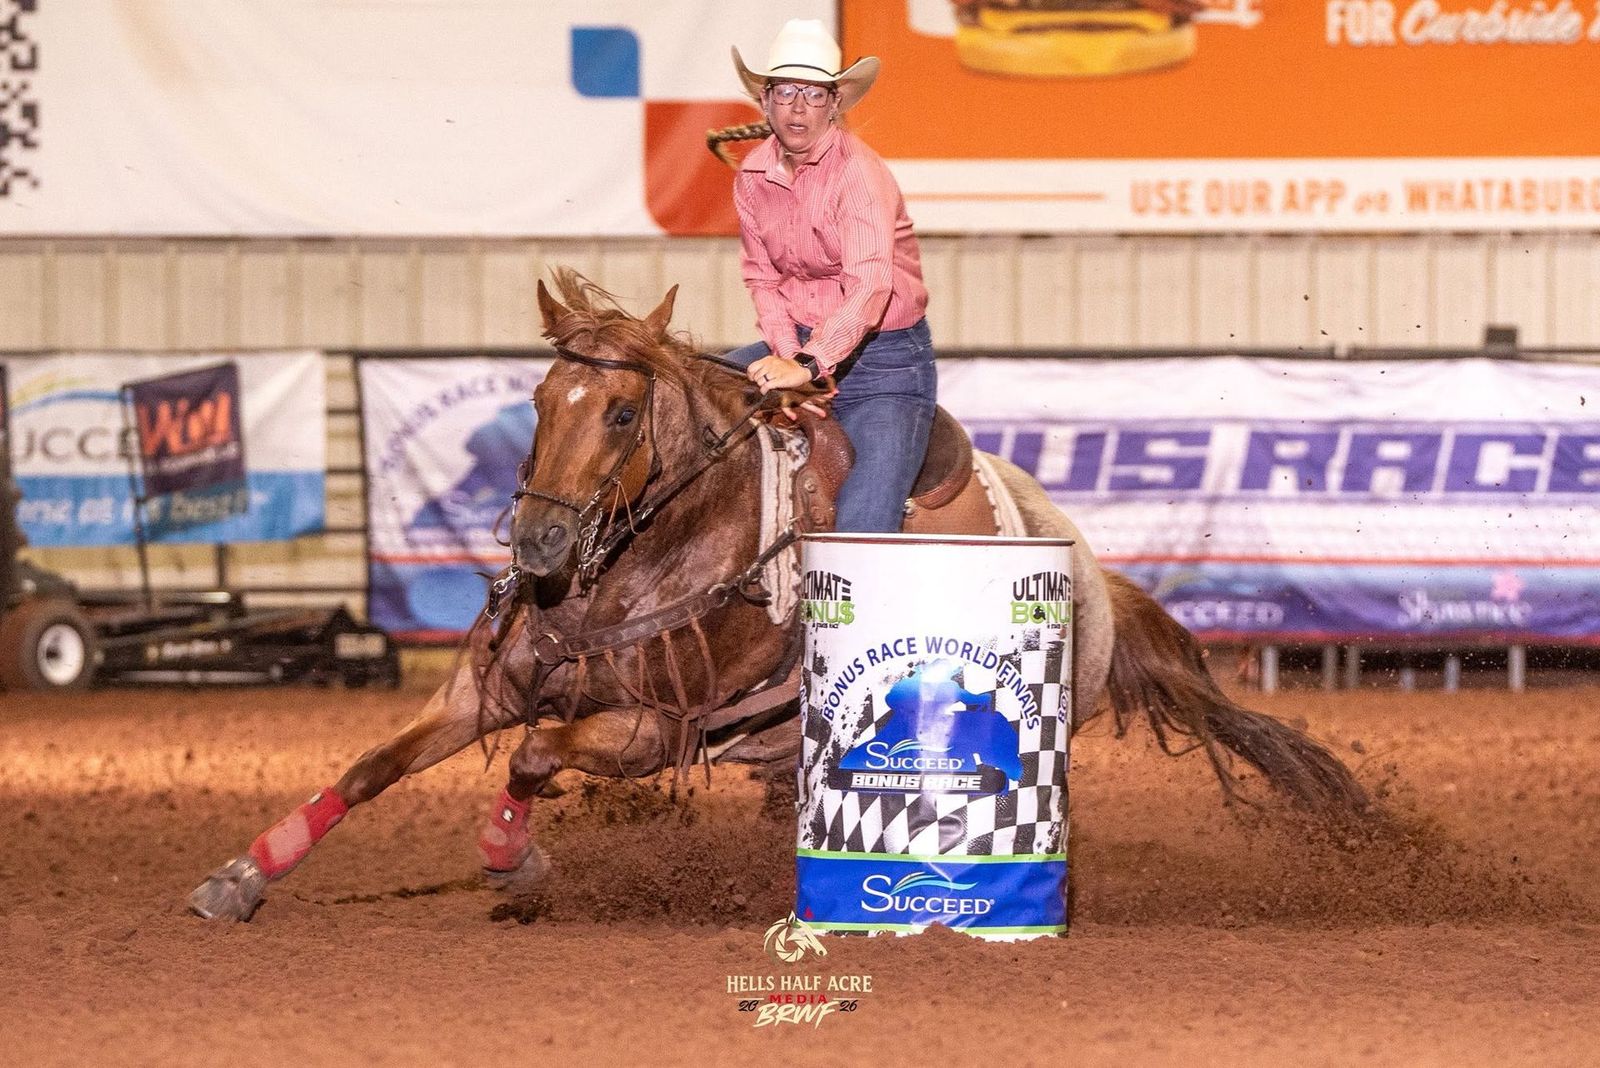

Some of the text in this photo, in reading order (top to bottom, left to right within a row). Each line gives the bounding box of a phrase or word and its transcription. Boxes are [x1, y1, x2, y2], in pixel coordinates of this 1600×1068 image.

[1326, 0, 1396, 46] FOR
[1130, 179, 1192, 215] USE
[1204, 179, 1273, 215] OUR
[1282, 179, 1347, 214] APP
[823, 657, 865, 722] BONUS
[866, 637, 918, 667] RACE
[925, 636, 997, 670] WORLD
[999, 664, 1040, 730] FINALS
[852, 773, 982, 791] BONUS RACE
